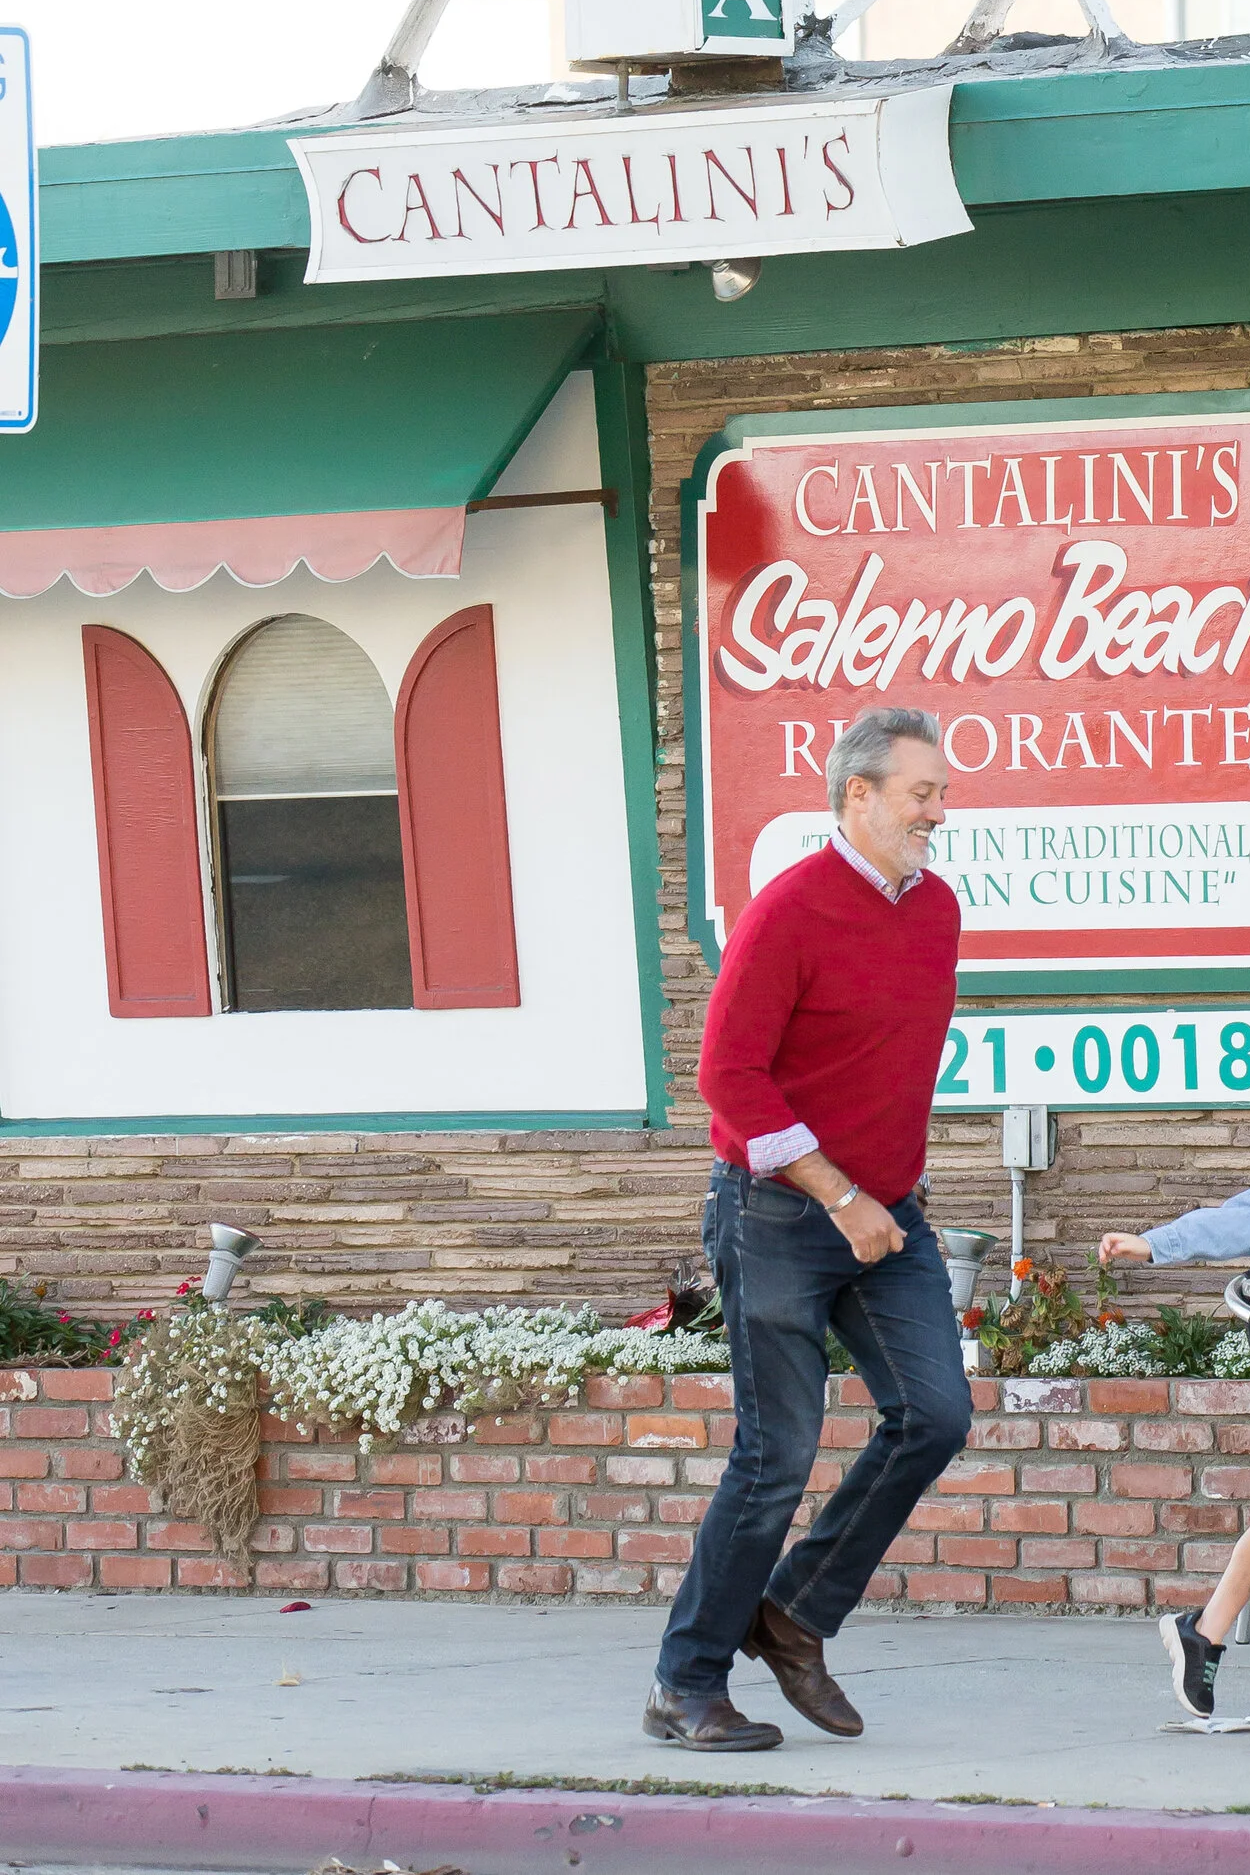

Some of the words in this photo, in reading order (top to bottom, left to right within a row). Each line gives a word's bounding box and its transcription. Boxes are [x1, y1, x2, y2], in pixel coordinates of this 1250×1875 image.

[337, 127, 854, 243] CANTALINI'S
[796, 440, 1239, 534] CANTALINI'S
[718, 552, 1036, 691] Salerno
[970, 827, 1006, 862] IN
